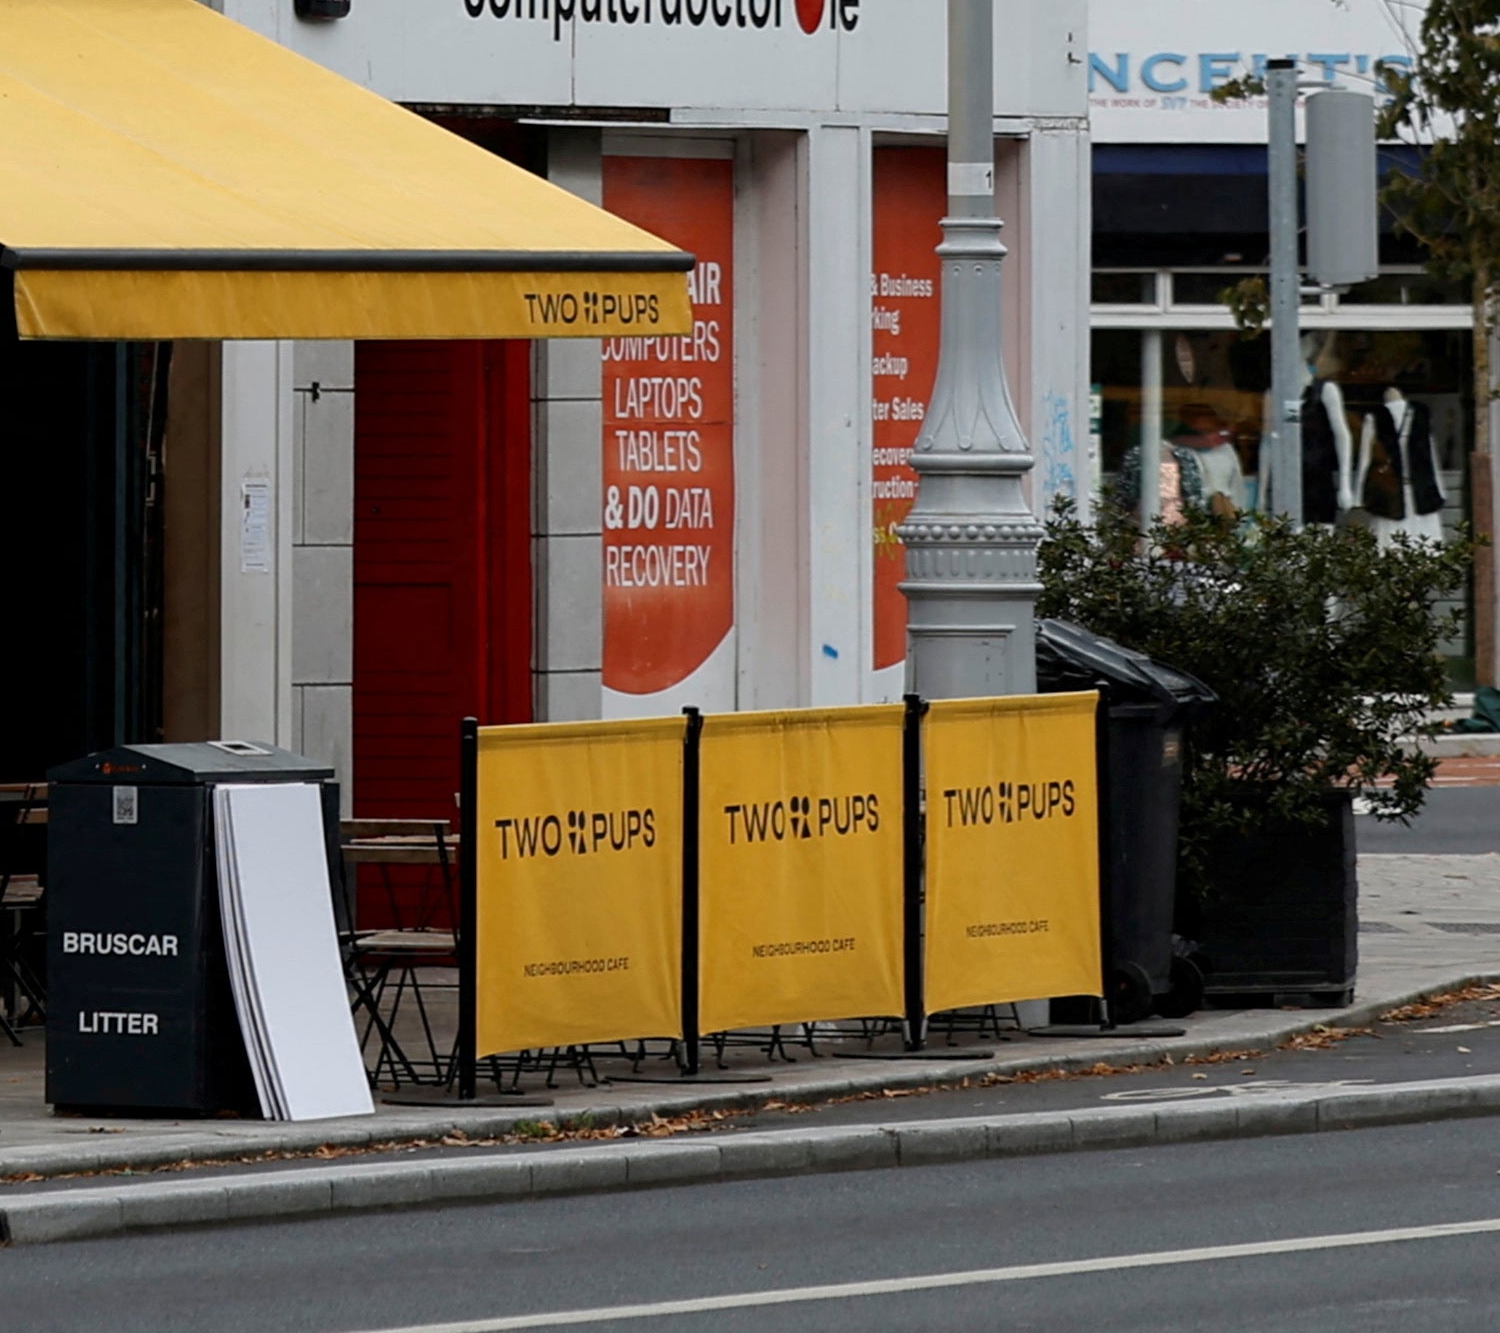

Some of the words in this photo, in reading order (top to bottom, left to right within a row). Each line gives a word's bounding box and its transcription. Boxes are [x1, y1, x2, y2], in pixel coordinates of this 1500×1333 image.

[881, 273, 933, 298] Business
[523, 292, 579, 325] TWO
[602, 293, 660, 325] PUPS
[615, 377, 702, 419] LAPTOPS
[891, 397, 925, 421] Sales
[615, 430, 701, 472] TABLETS
[604, 485, 623, 529] &
[627, 486, 659, 530] DO
[665, 488, 714, 529] DATA
[606, 545, 711, 587] RECOVERY
[724, 800, 786, 845] TWO
[818, 793, 880, 837] PUPS
[945, 786, 995, 828] TWO
[1017, 779, 1075, 822] PUPS
[494, 814, 562, 860] TWO
[592, 808, 657, 853] PUPS
[63, 932, 179, 957] BRUSCAR
[965, 921, 1027, 939] NEIGHBOURHOOD
[1029, 919, 1049, 934] CAFE
[752, 939, 831, 959] NEIGHBOURHOOD
[832, 937, 856, 954] CAFE
[523, 958, 607, 978] NEIGHBOURHOOD
[606, 957, 630, 974] CAFE
[78, 1011, 159, 1035] LITTER
